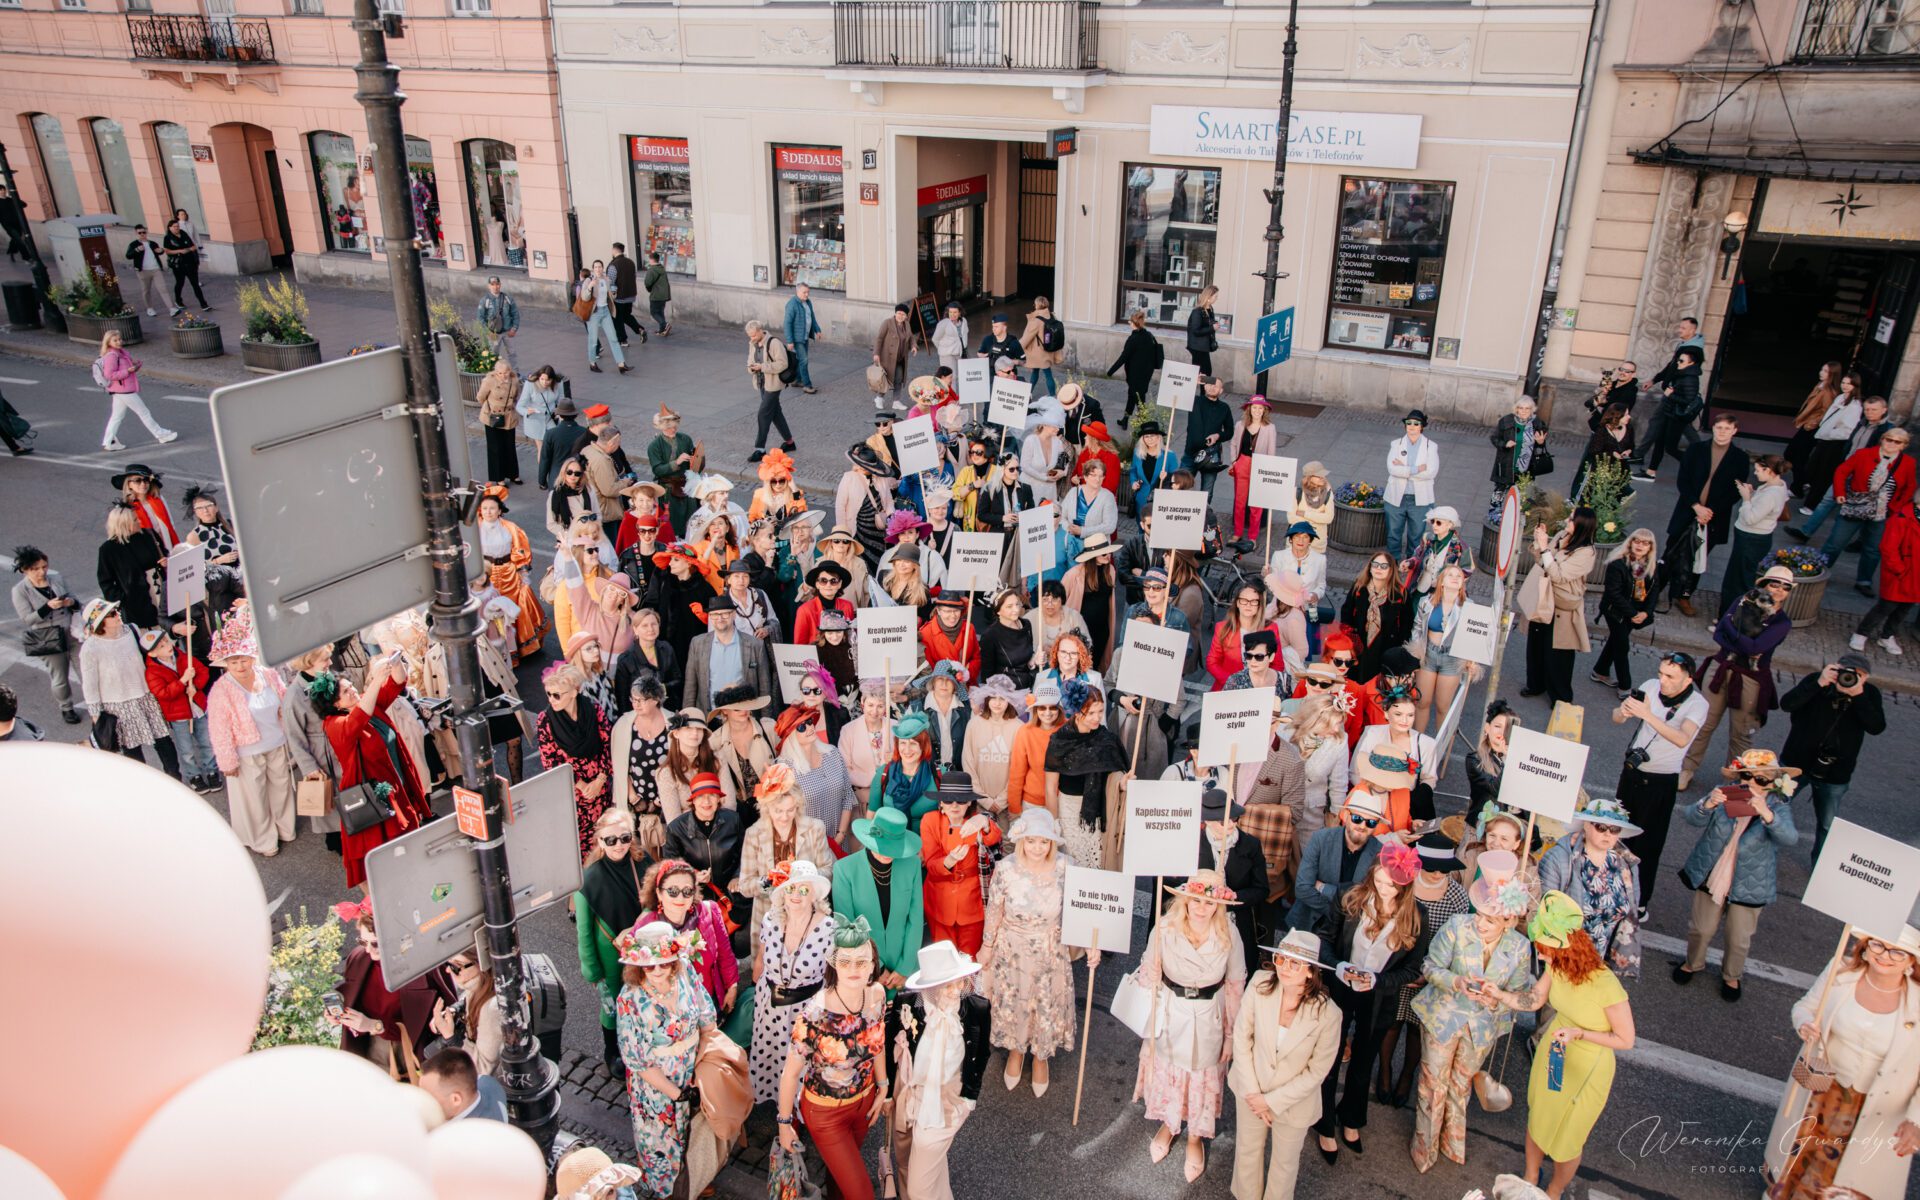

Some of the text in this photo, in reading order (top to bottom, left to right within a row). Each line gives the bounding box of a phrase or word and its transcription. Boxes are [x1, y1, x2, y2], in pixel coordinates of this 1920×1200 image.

[644, 145, 689, 158] DEDALUS
[1058, 140, 1071, 152] GSM
[1195, 144, 1246, 155] Akcesoria
[1246, 145, 1257, 155] do
[1260, 146, 1303, 158] Tabtów
[1313, 148, 1364, 161] Telefonów
[789, 153, 842, 166] DEDALUS
[865, 154, 874, 164] 61
[782, 172, 799, 180] skład
[819, 174, 842, 183] książek
[939, 182, 970, 199] DEDALUS
[80, 226, 103, 236] BILETY
[1376, 255, 1411, 263] OCHRONNE
[1338, 269, 1375, 277] POWERBANKI
[1342, 310, 1385, 320] POWERBANK
[1158, 505, 1201, 516] Styl zaczyna się
[1174, 514, 1192, 522] głowy
[962, 548, 989, 556] kapeluszu
[867, 624, 908, 635] Kreatywność
[882, 636, 902, 644] głowie
[1134, 641, 1152, 652] Moda
[1157, 647, 1175, 660] klasą
[1214, 710, 1260, 720] Głowa pełna
[1226, 721, 1245, 730] stylu
[1529, 753, 1561, 770] Kocham
[1518, 761, 1568, 783] fascynatory!
[1135, 807, 1192, 818] Kapelusz mówi
[1145, 820, 1182, 831] wszystko
[1850, 852, 1892, 876] Kocham
[1839, 862, 1894, 892] kapelusze!
[1078, 889, 1119, 902] To nie tylko
[1071, 900, 1102, 911] kapelusz
[1108, 905, 1116, 913] to
[1117, 906, 1125, 915] ja
